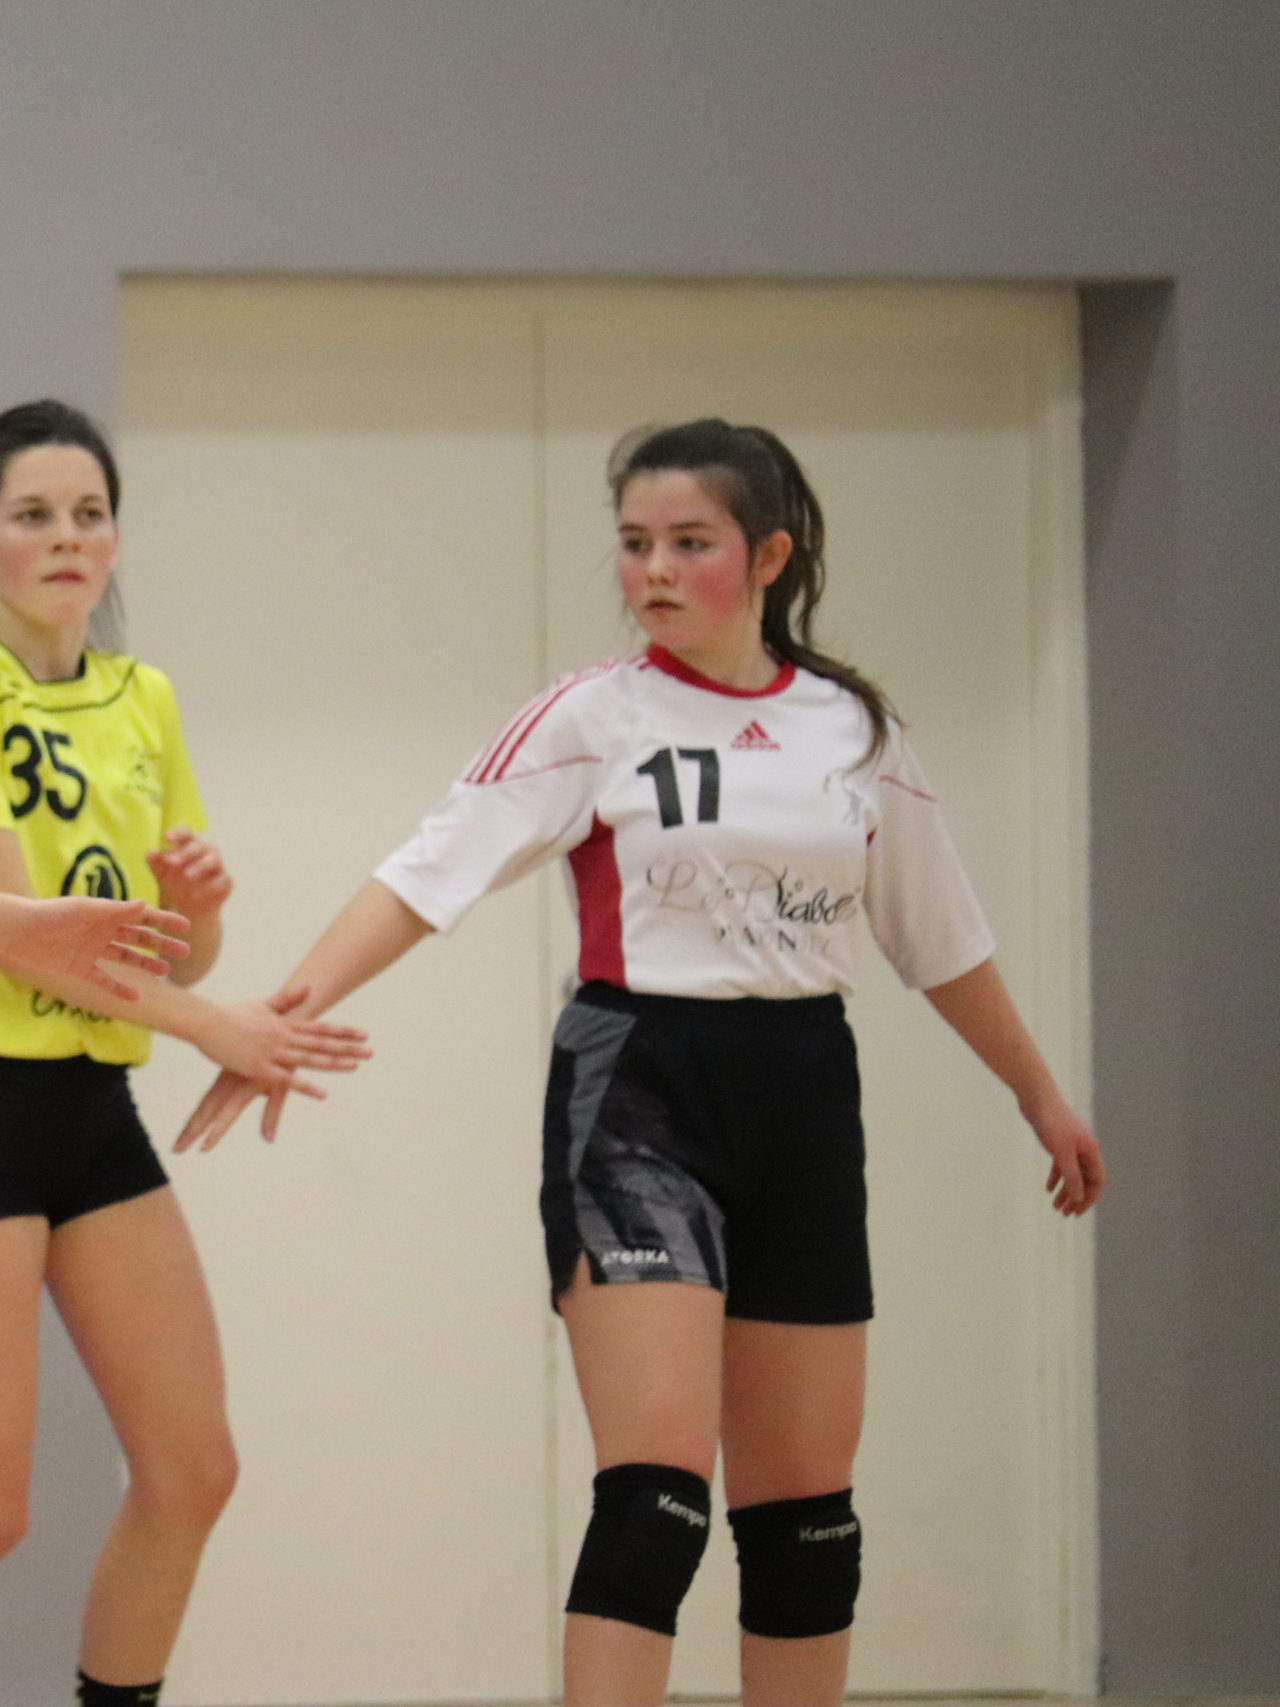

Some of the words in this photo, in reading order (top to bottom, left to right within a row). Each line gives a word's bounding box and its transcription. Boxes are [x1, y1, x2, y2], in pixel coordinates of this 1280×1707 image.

[3, 724, 88, 822] 35
[635, 747, 720, 830] 17
[658, 1493, 707, 1528] Kempa
[800, 1520, 858, 1543] Kempa
